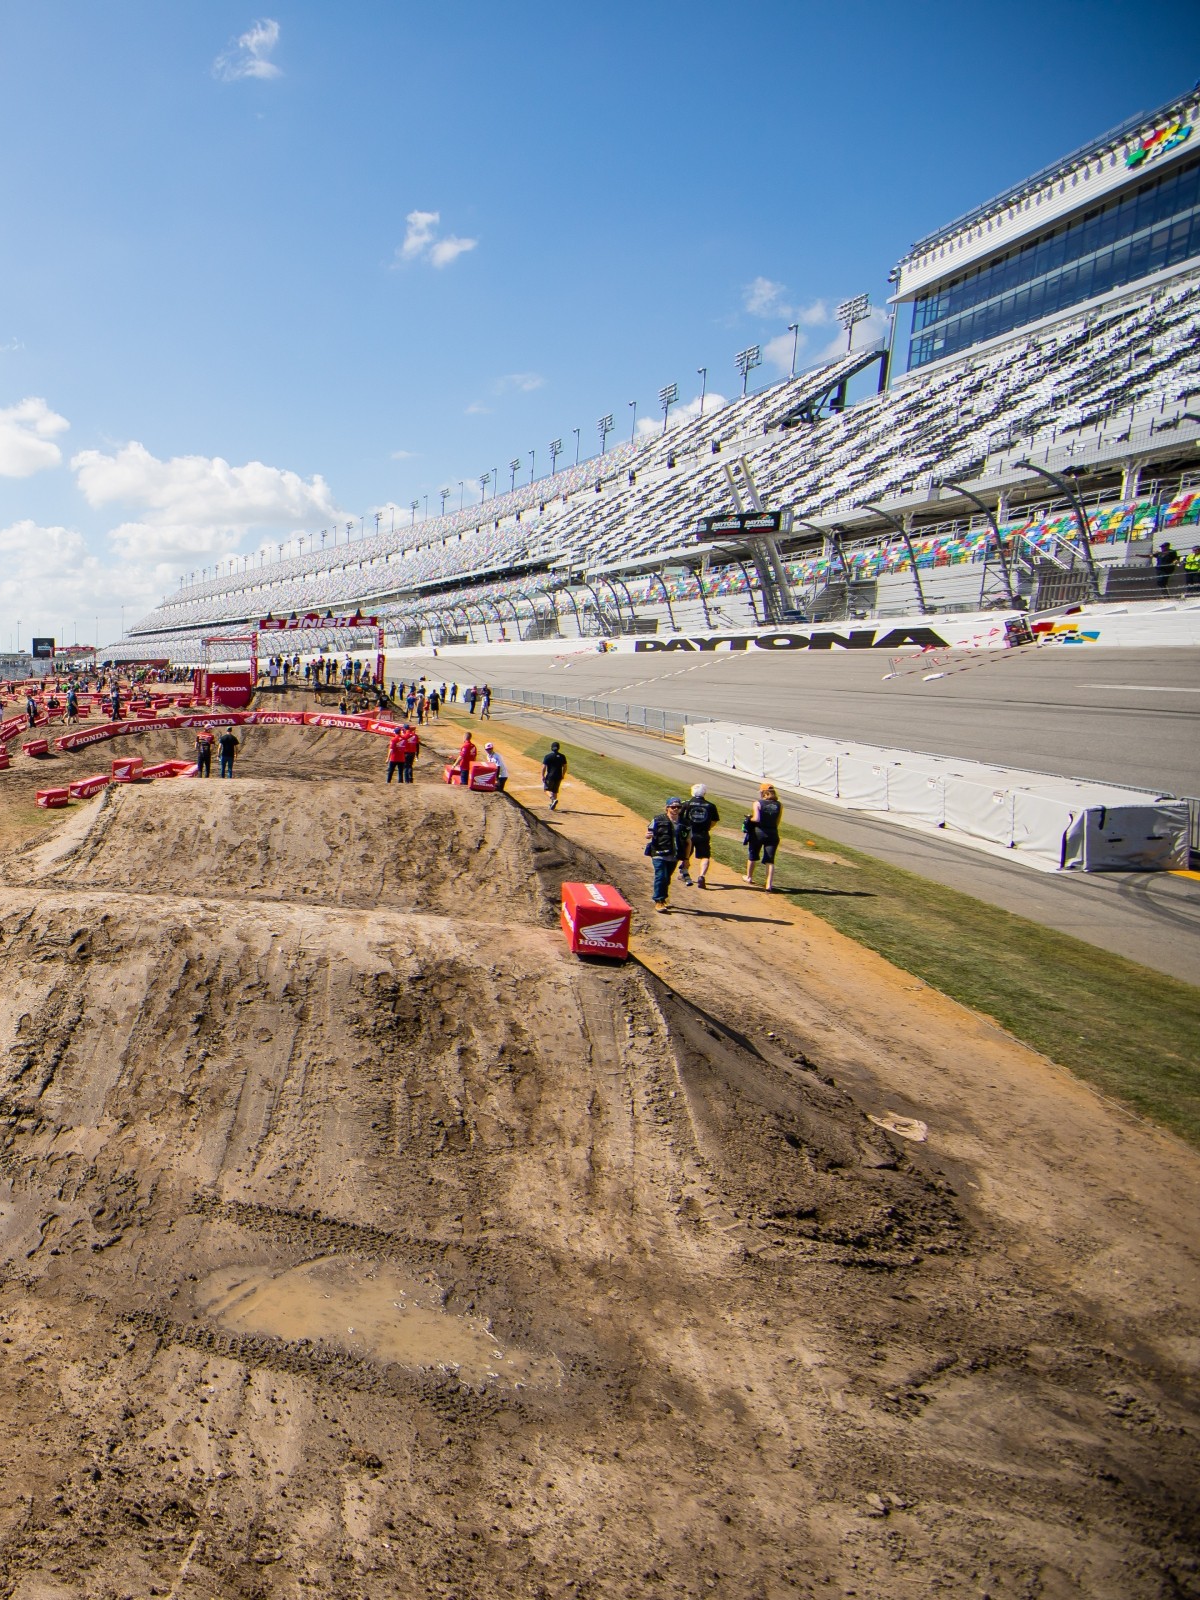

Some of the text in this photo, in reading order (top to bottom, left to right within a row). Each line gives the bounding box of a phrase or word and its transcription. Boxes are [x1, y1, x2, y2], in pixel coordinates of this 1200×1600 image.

[284, 617, 352, 629] FINISH
[634, 627, 951, 653] DAYTONA
[192, 718, 236, 727] HONDA
[257, 716, 298, 725] HONDA
[320, 717, 362, 730] HONDA
[128, 723, 170, 733] HONDA
[75, 731, 110, 744] HONDA
[579, 938, 625, 949] HONDA
